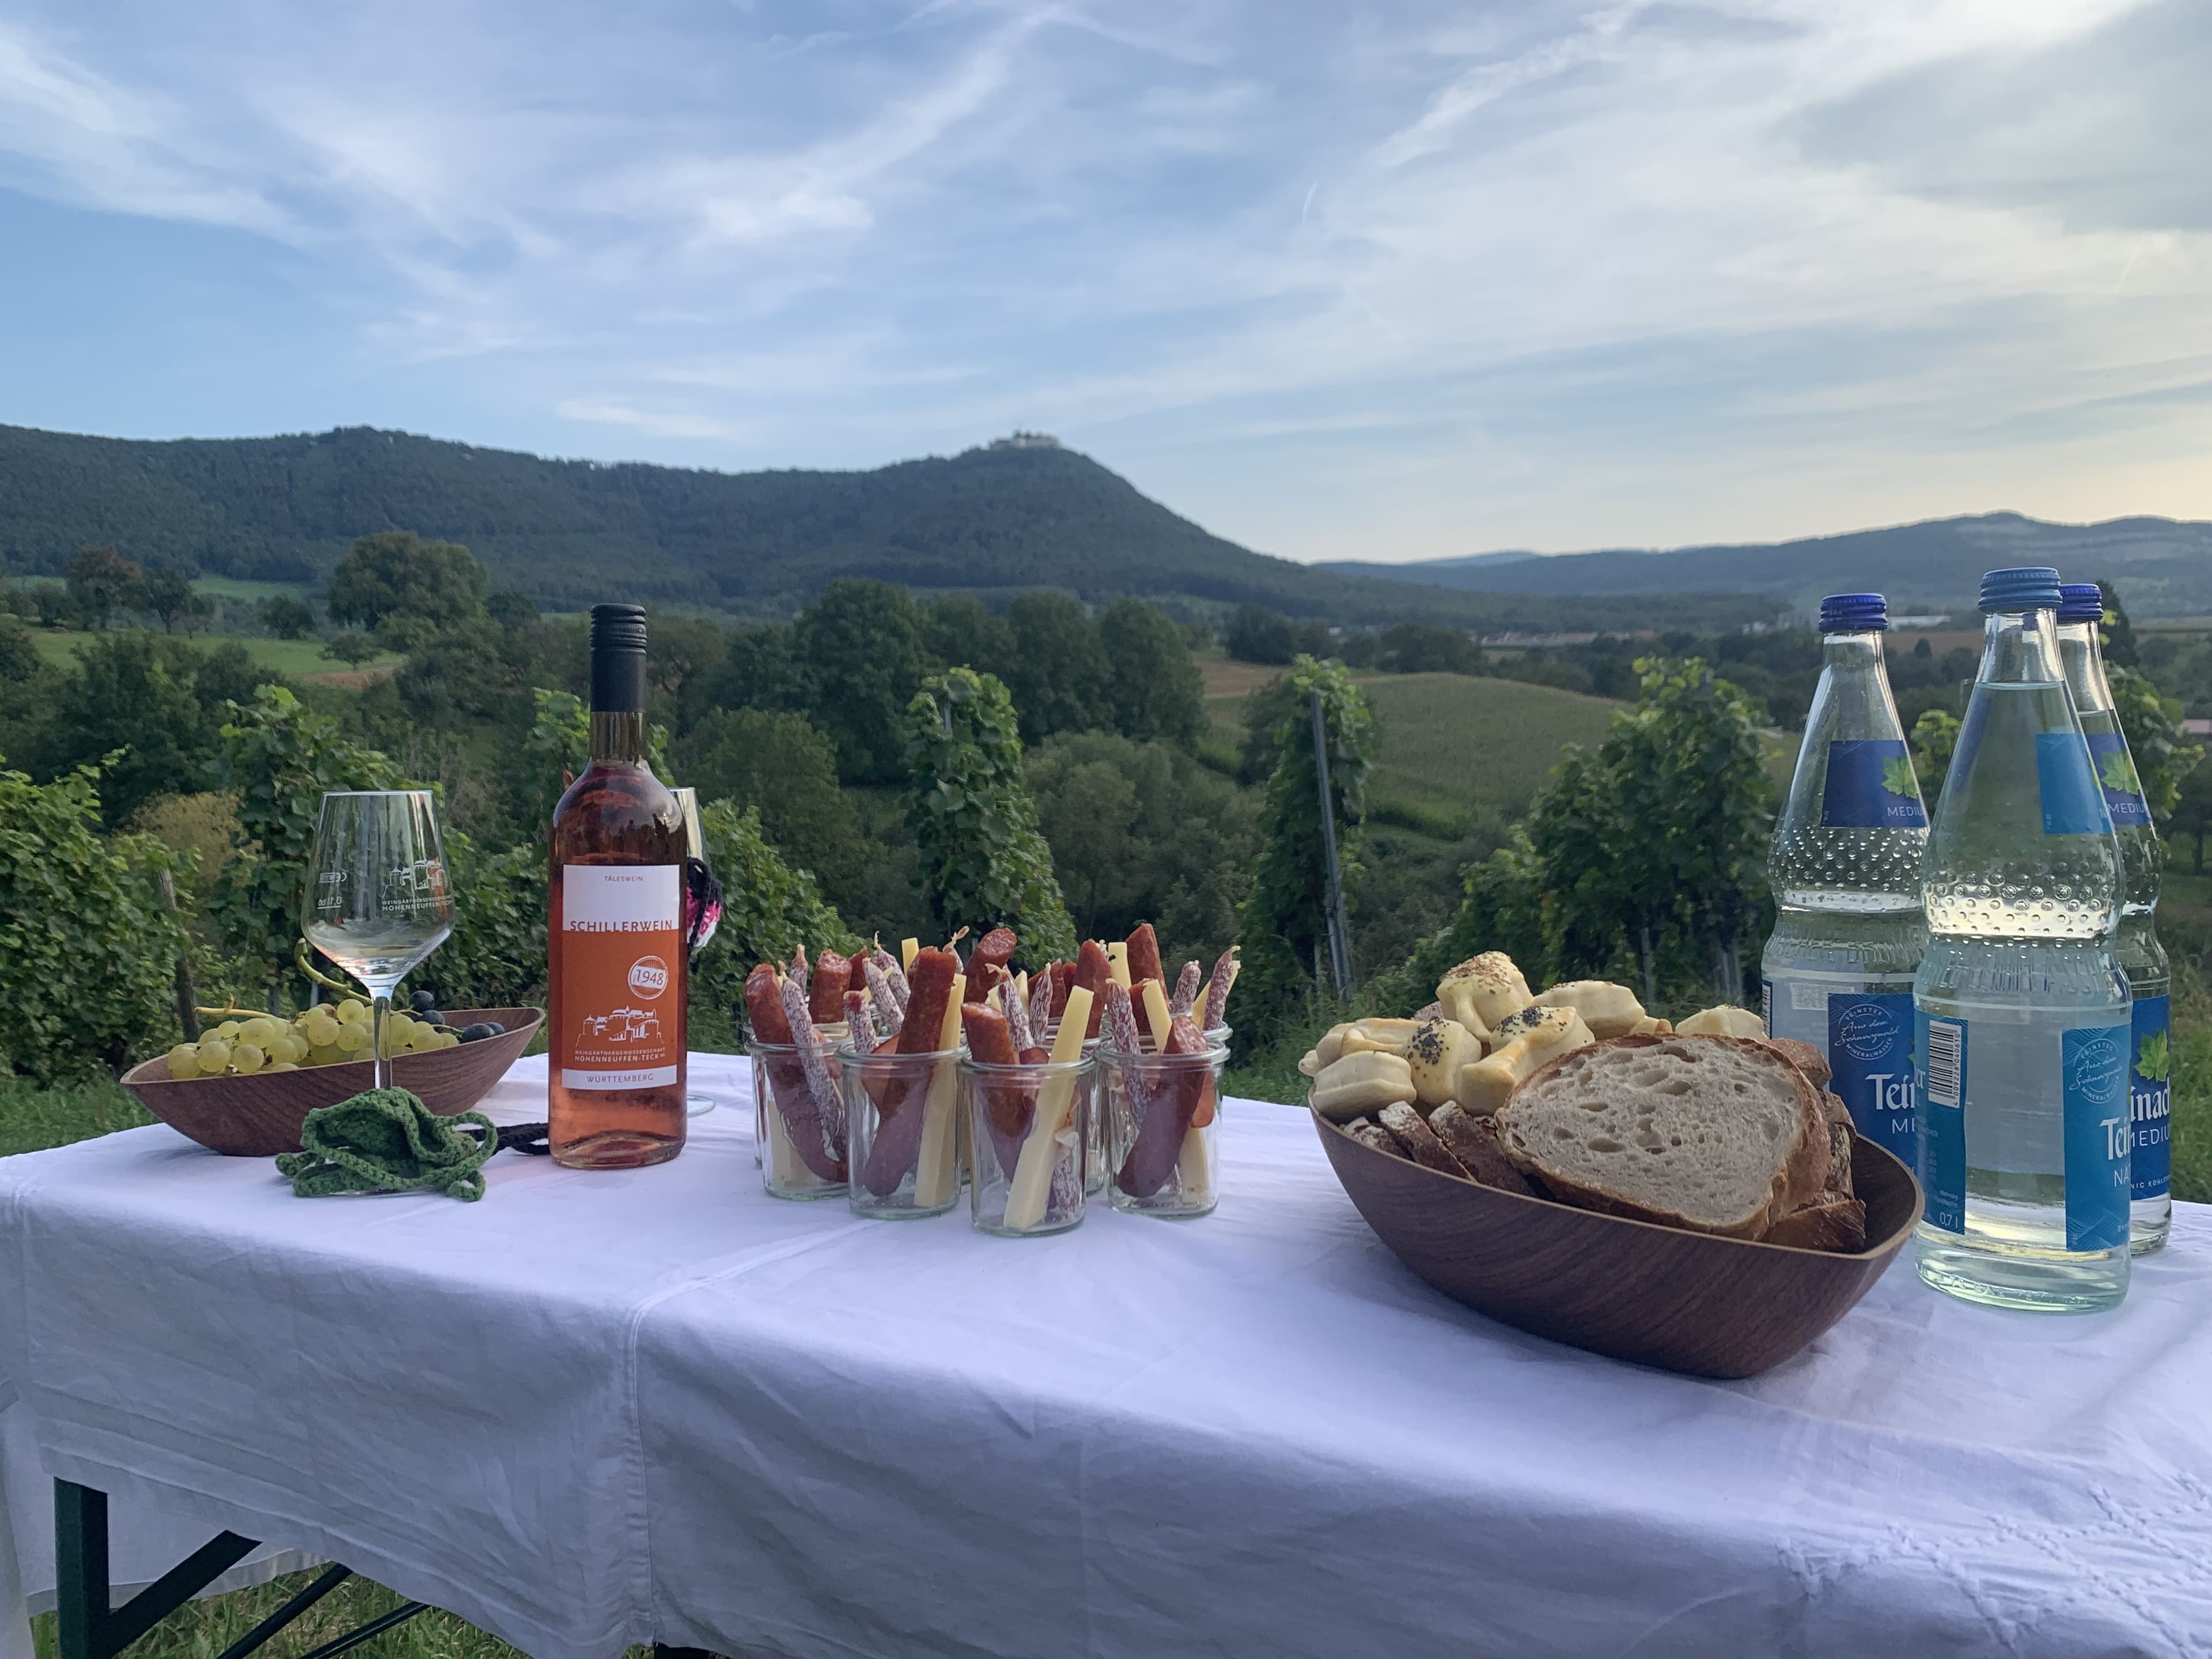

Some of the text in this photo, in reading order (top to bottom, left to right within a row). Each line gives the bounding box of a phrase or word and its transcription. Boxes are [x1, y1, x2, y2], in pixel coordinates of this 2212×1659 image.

[1887, 806, 1923, 816] MEDIU
[2108, 803, 2145, 813] MEDIU
[570, 920, 672, 932] SCHILLERWEIN
[636, 969, 664, 985] 1948
[1846, 1007, 1883, 1021] FEINSTES
[1846, 1037, 1893, 1057] MINERALWASSER
[575, 1053, 658, 1062] HOHENNEUFFEN-TECK
[587, 1074, 654, 1083] WÜRTTEMBERG
